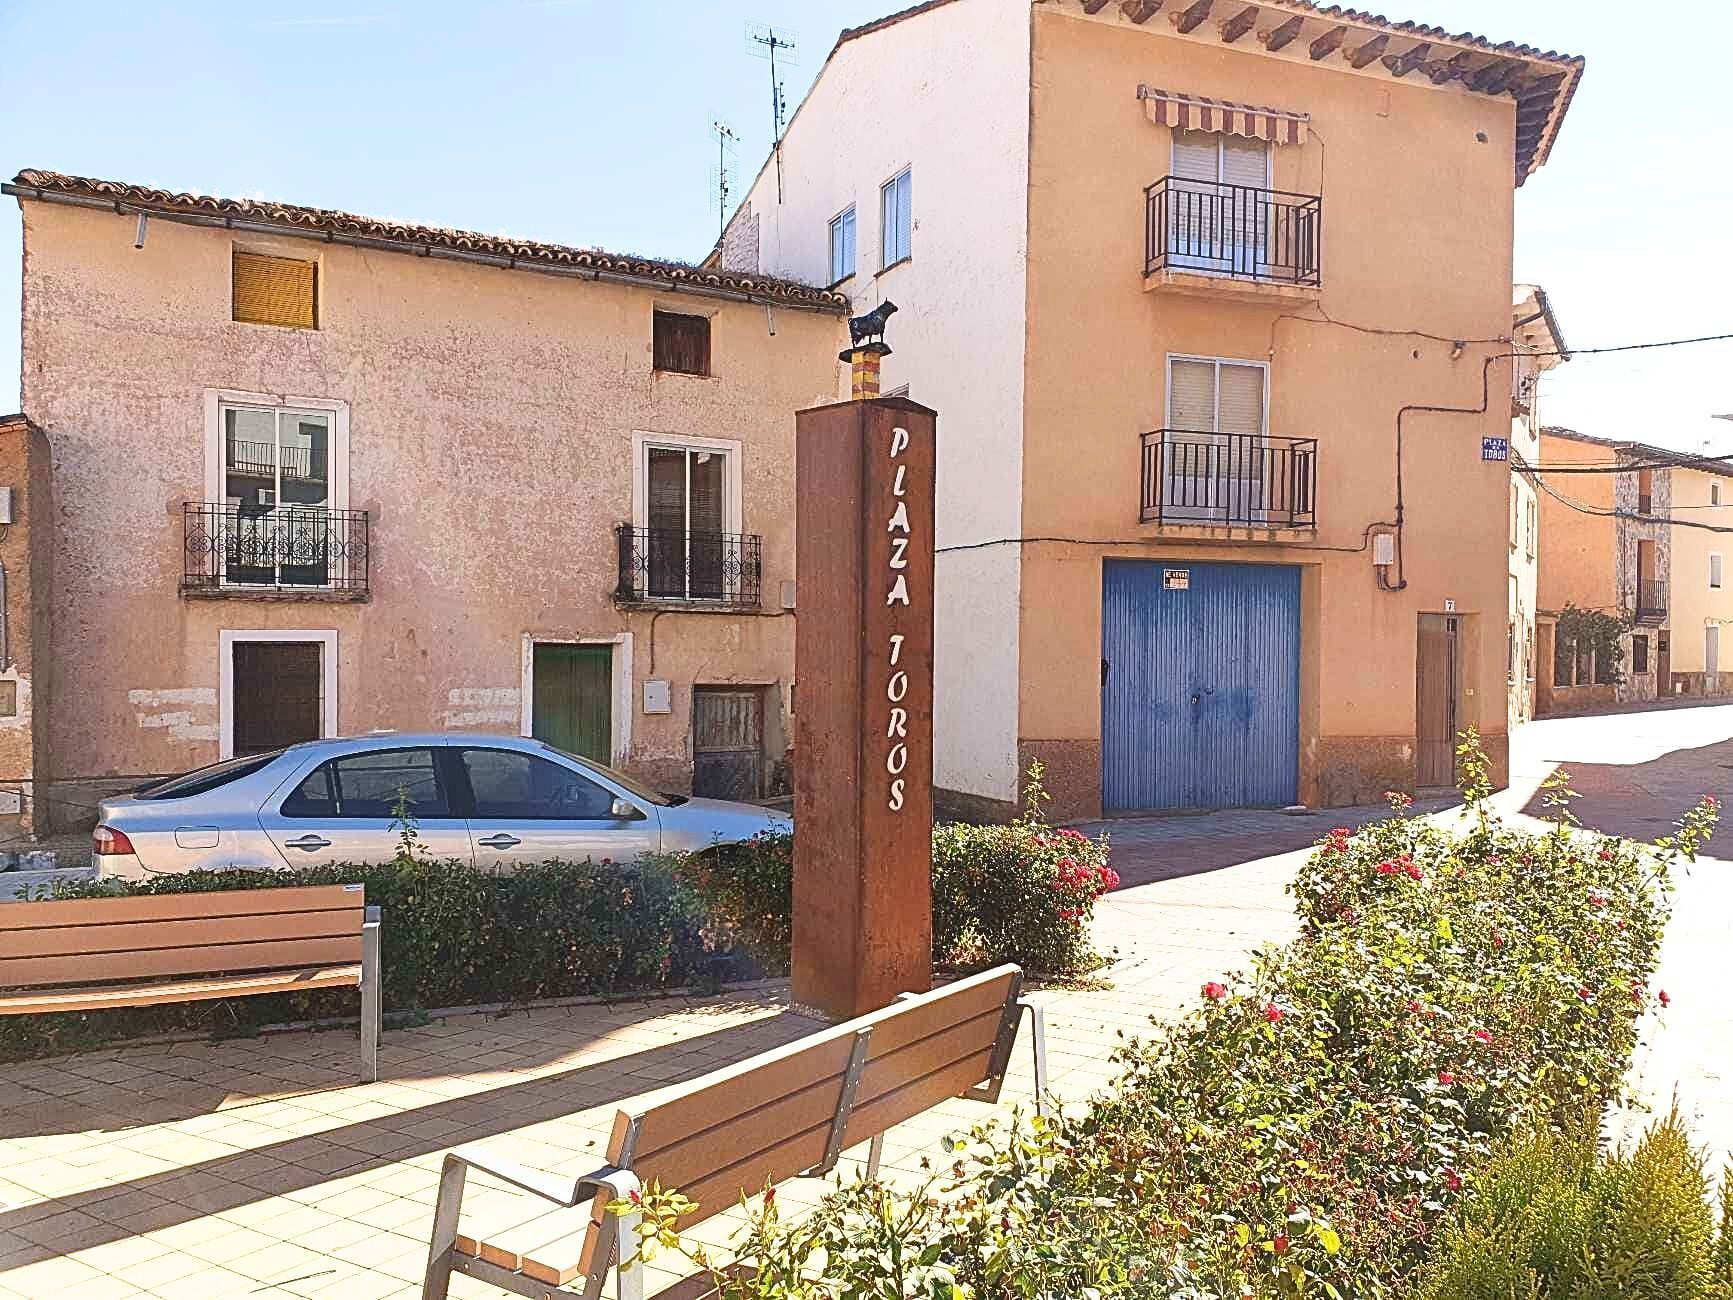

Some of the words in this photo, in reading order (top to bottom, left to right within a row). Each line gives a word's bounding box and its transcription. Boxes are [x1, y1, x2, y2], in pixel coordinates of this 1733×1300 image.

[1484, 438, 1506, 447] PLAZA
[1484, 449, 1506, 460] TOROS
[887, 427, 911, 606] PLAZA
[1448, 602, 1453, 610] 7
[886, 634, 909, 811] TOROS
